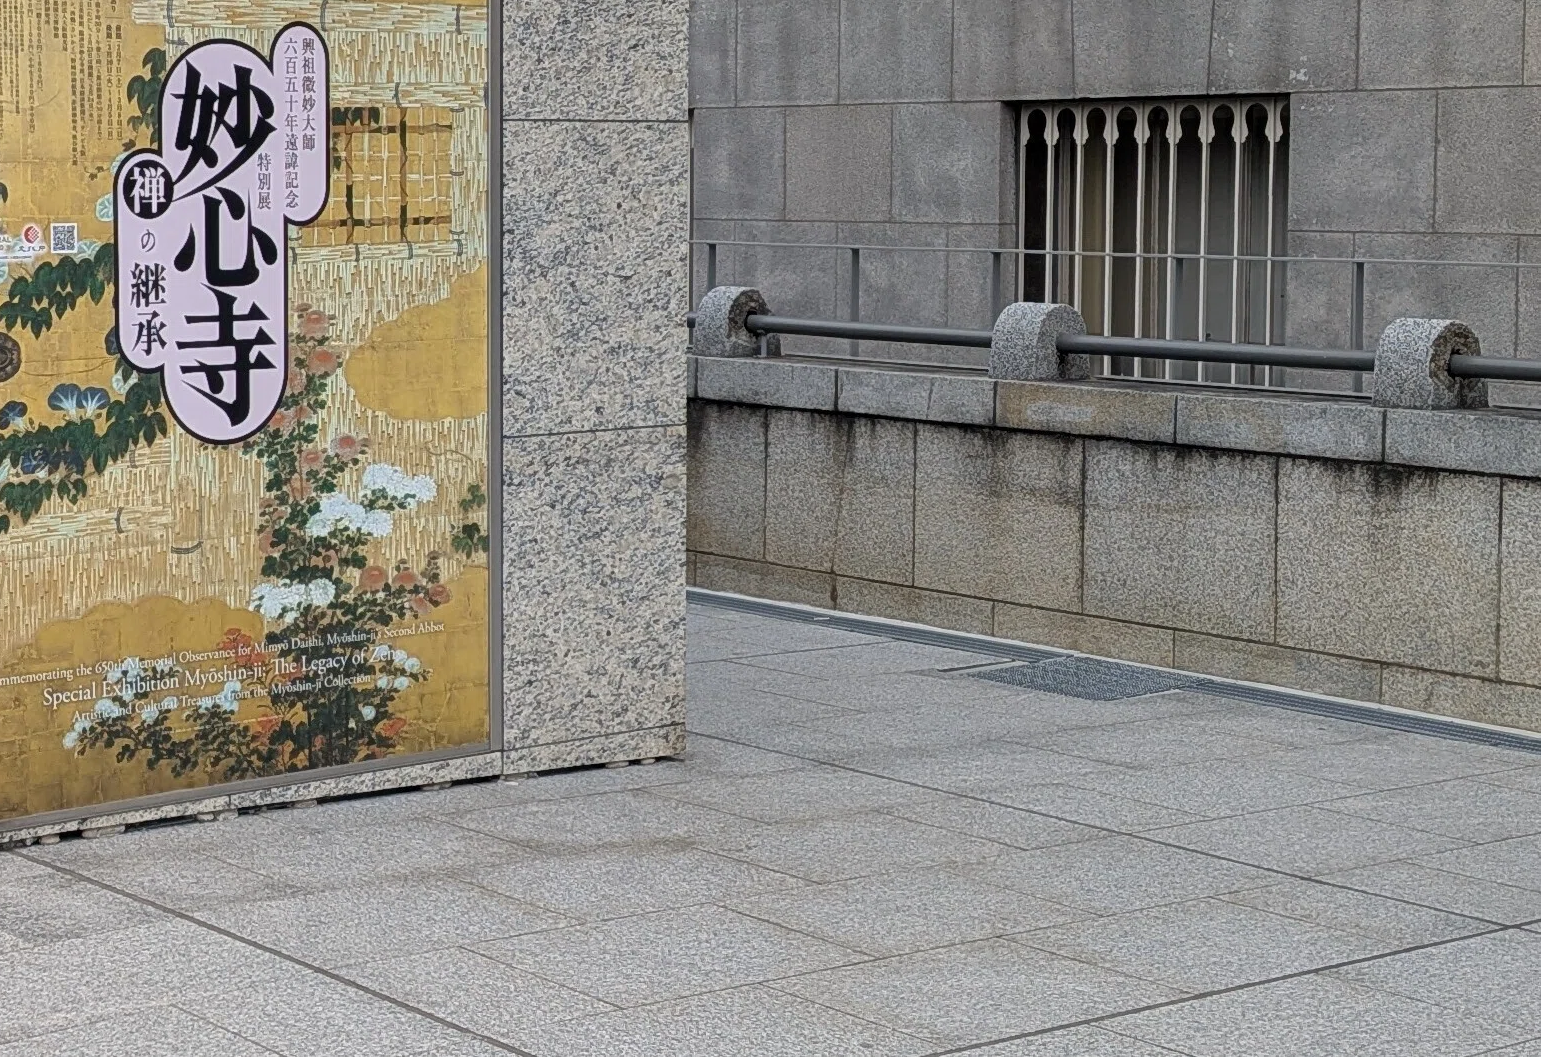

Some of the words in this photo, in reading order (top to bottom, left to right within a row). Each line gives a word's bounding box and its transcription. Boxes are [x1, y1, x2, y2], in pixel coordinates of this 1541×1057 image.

[284, 37, 300, 208] 六百五十年遠諱記念
[301, 37, 317, 151] 興祖微妙大師
[257, 152, 272, 210] 特別展
[129, 166, 168, 357] 禅の継承
[170, 57, 278, 427] 妙心寺
[42, 685, 97, 710] Special
[101, 675, 180, 698] Exhibition
[270, 657, 298, 675] The
[301, 654, 348, 675] Legacy
[351, 646, 368, 664] of
[369, 648, 397, 663] Zen
[75, 665, 93, 677] the
[95, 659, 125, 674] 650th
[127, 654, 177, 670] Memorial
[178, 649, 236, 666] Observance
[237, 645, 251, 657] for
[383, 625, 416, 639] Second
[417, 622, 445, 635] Abbot
[71, 707, 112, 724] Artistic
[113, 704, 133, 717] and
[135, 697, 177, 714] Cultural
[178, 692, 224, 709] Treasures
[226, 687, 250, 702] from
[252, 685, 269, 698] the
[324, 673, 371, 689] Collection
